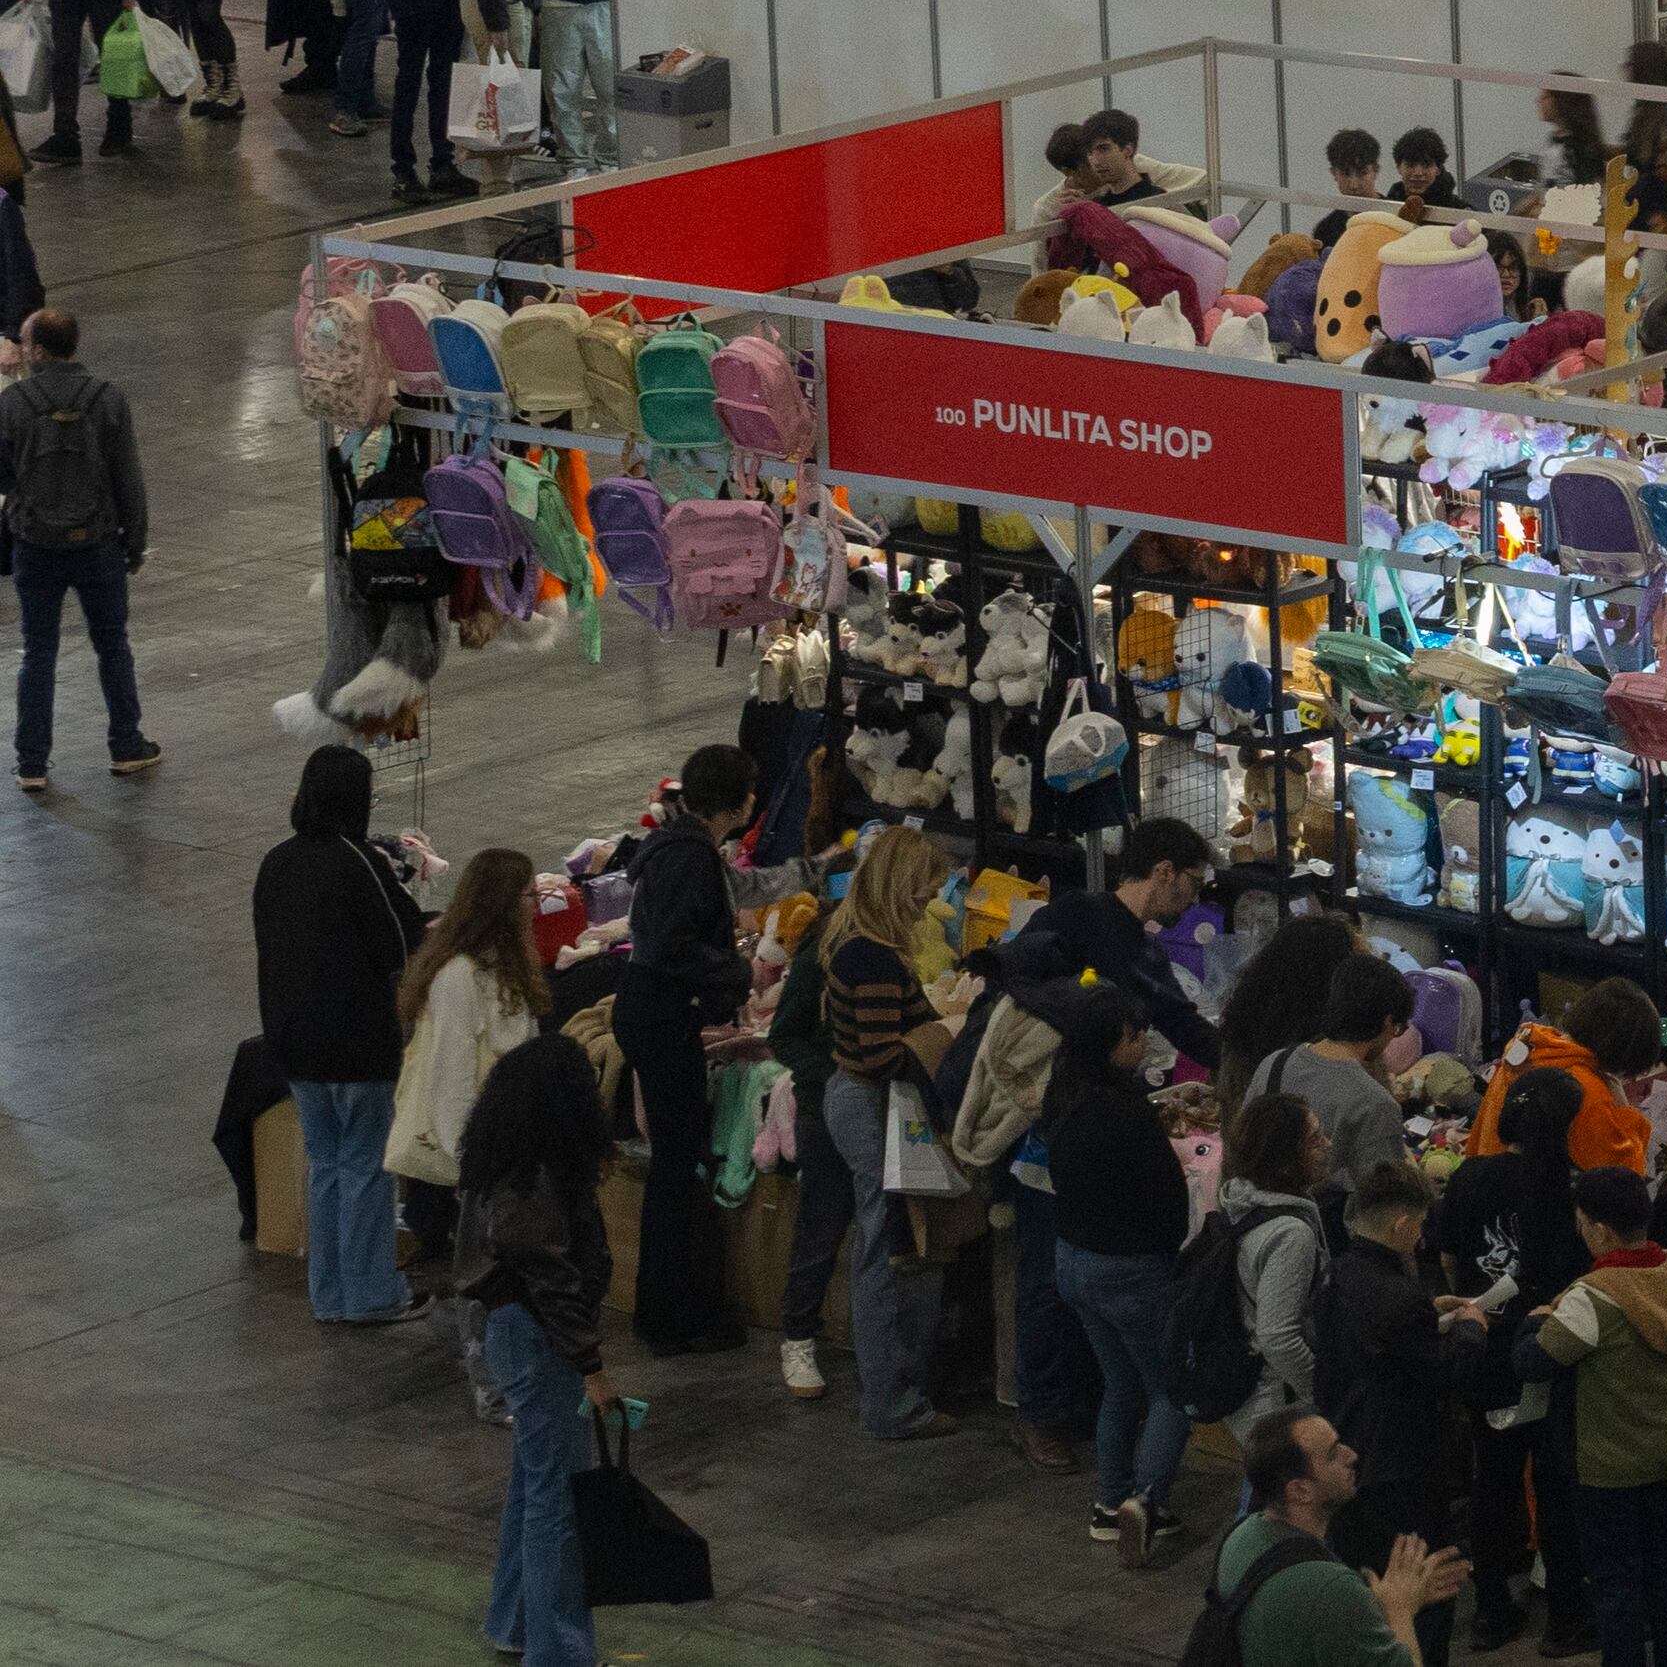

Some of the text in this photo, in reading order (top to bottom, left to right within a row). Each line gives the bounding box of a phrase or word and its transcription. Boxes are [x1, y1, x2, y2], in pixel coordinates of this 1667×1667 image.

[935, 399, 1213, 460] 100 PUNLITA SHOP
